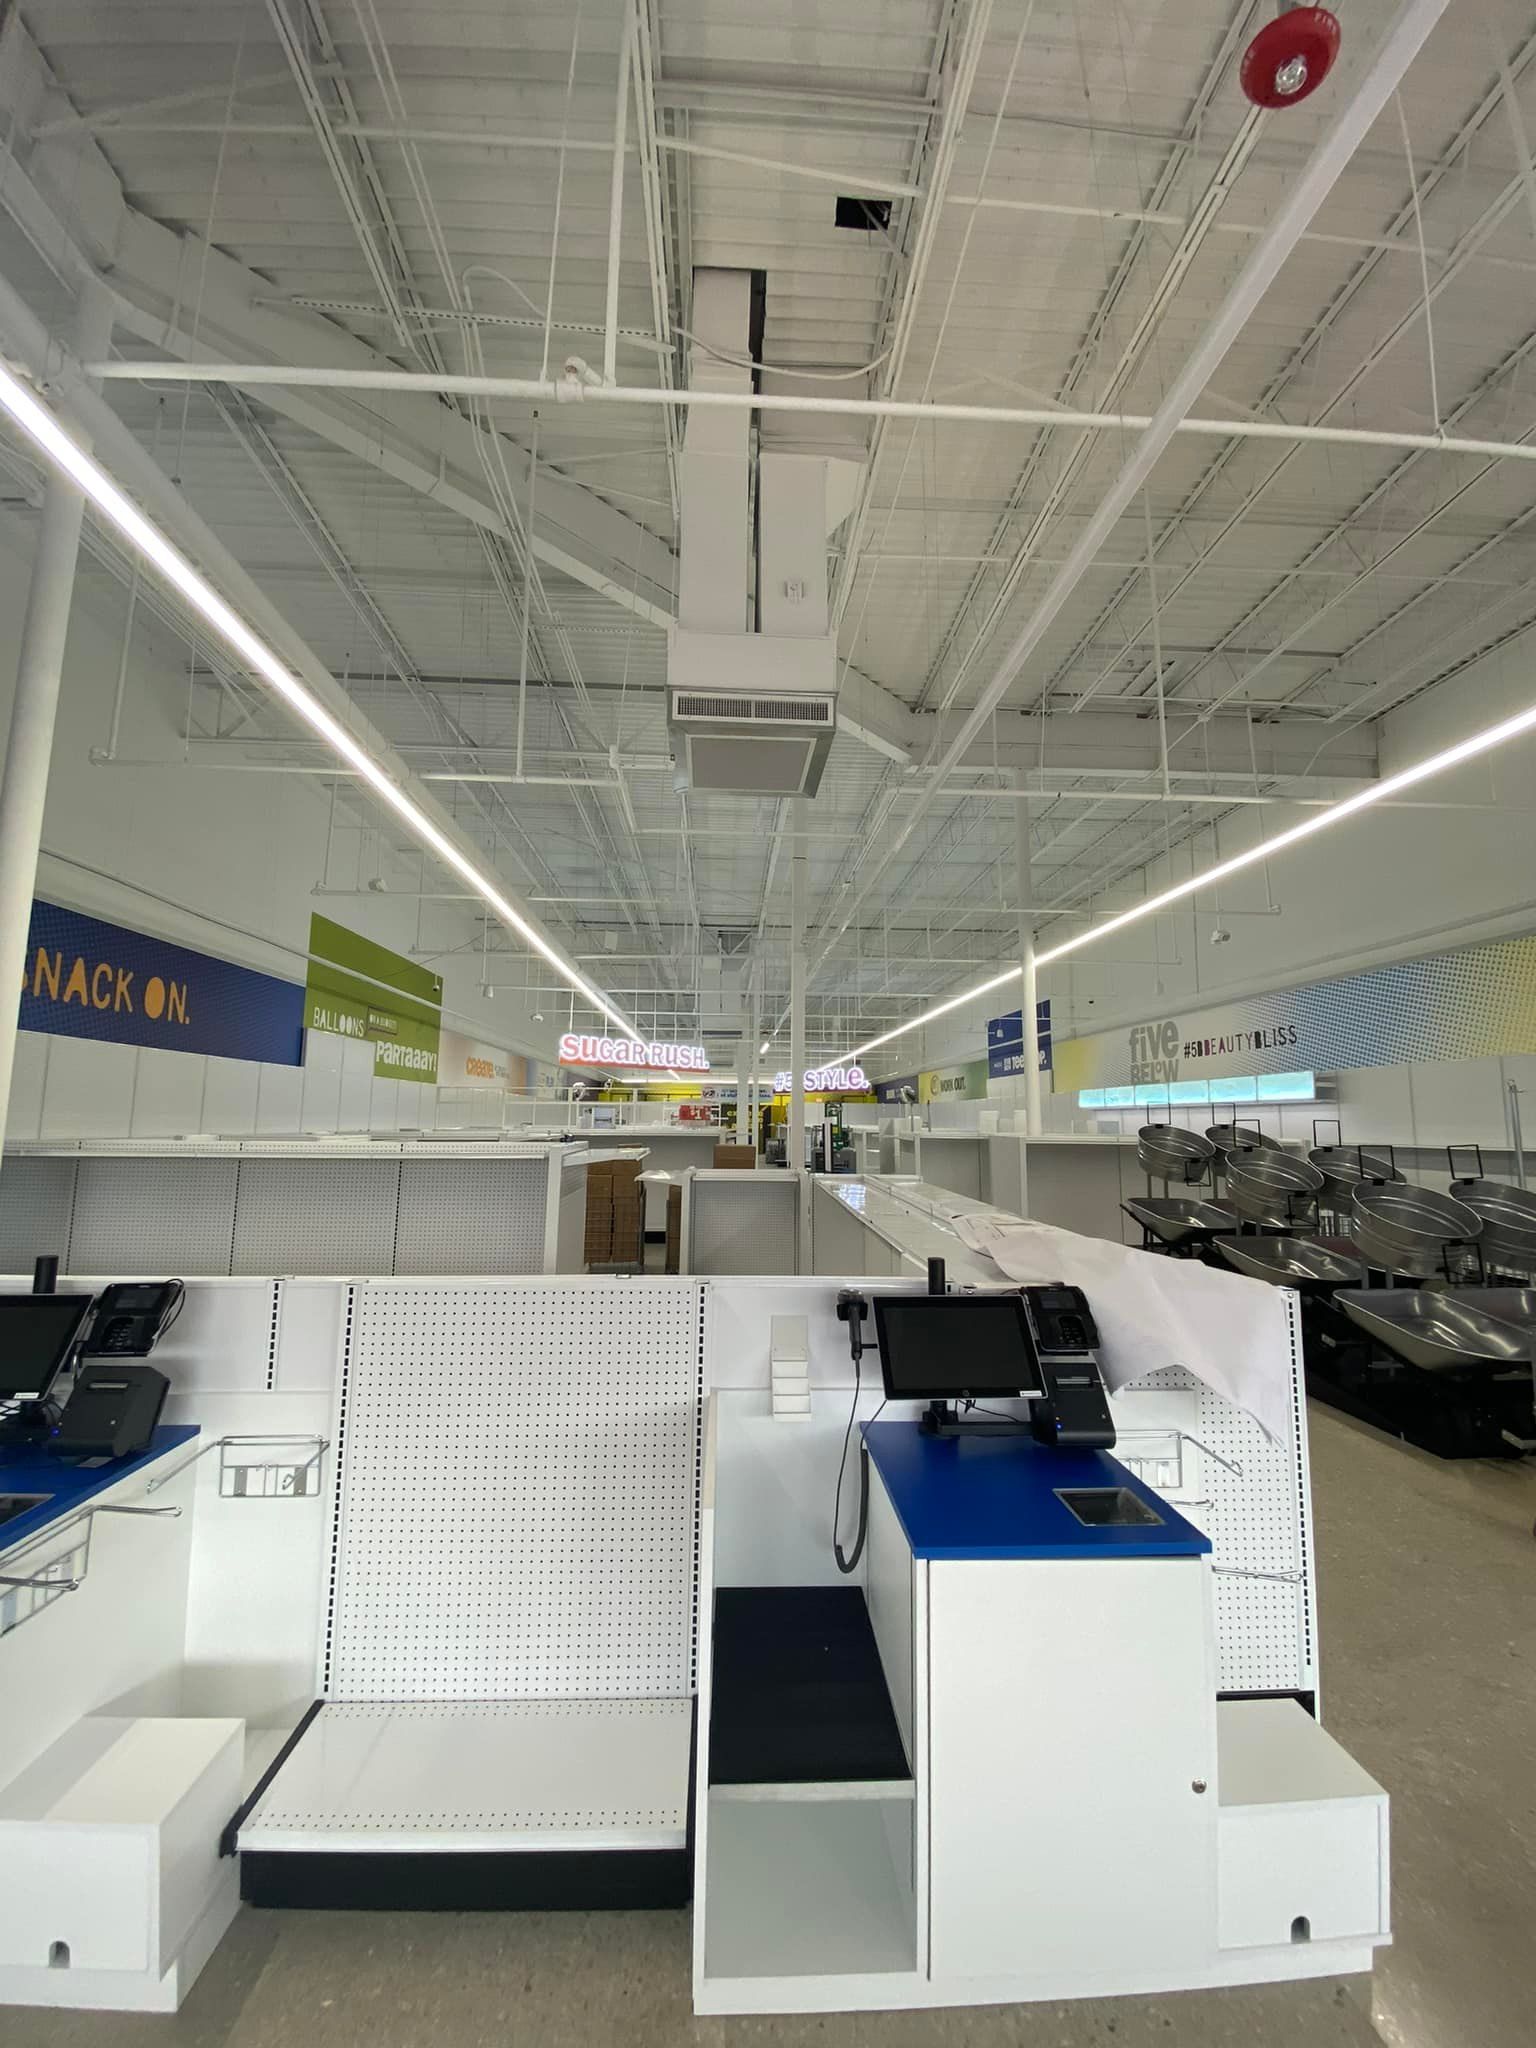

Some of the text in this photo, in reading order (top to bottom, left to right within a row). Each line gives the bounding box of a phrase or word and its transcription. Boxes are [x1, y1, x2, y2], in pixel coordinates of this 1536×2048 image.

[22, 947, 190, 1025] NACK ON.
[313, 1007, 365, 1038] BALLOONS
[1129, 1021, 1179, 1064] five
